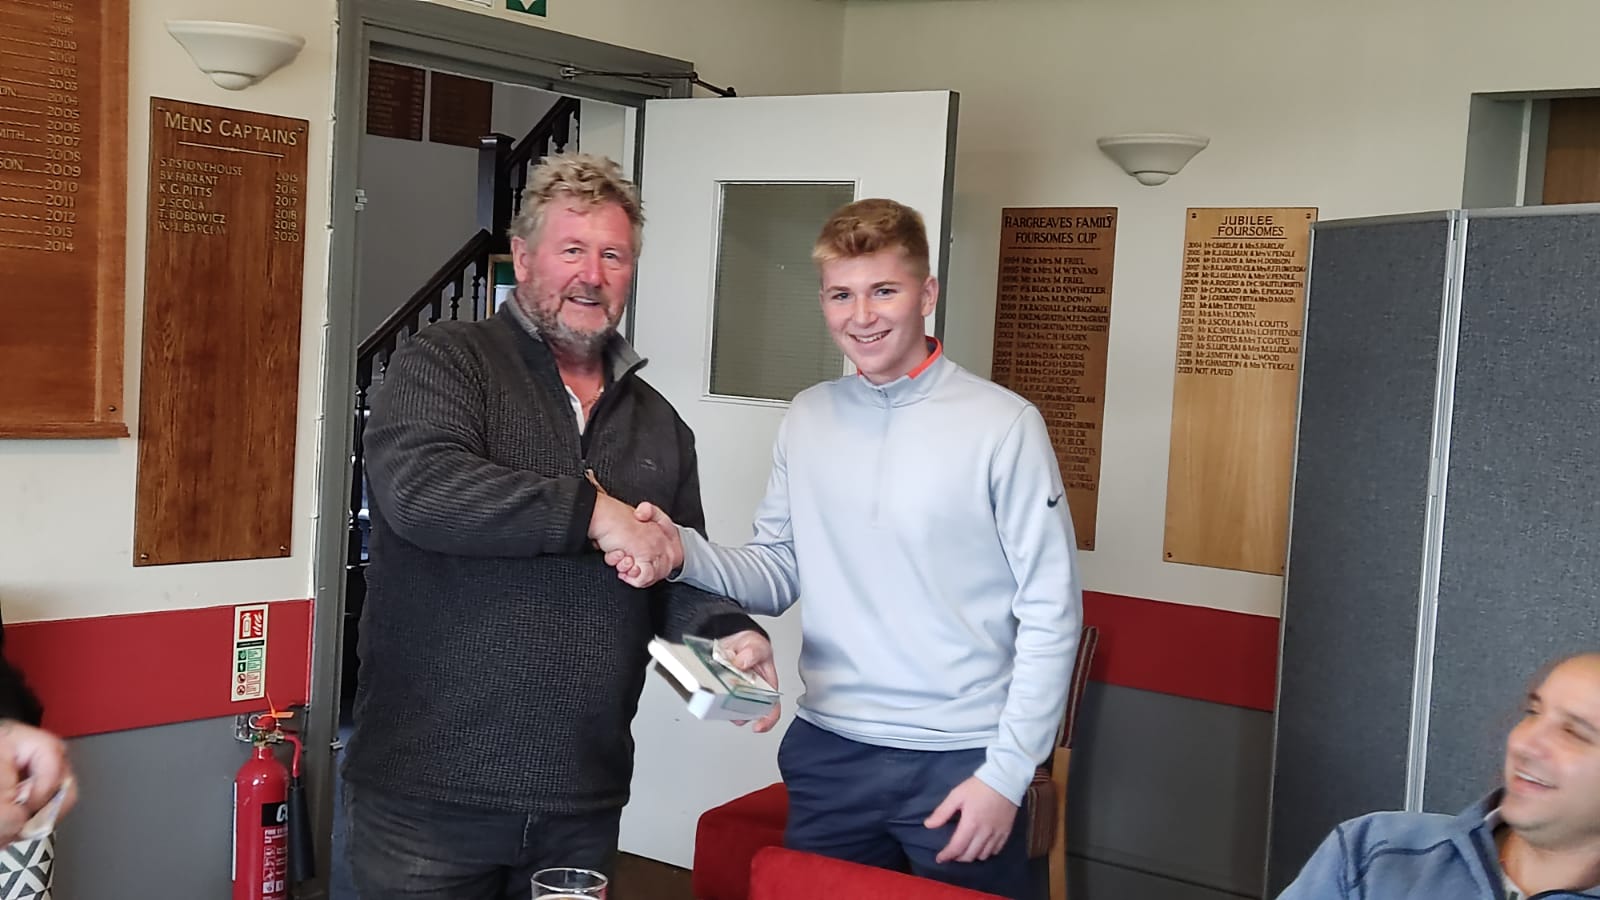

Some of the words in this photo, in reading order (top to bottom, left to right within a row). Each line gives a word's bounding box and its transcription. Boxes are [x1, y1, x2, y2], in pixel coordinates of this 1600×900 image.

[165, 111, 213, 134] MENS
[219, 119, 298, 146] CAPTAINS
[47, 133, 80, 147] 2007
[44, 162, 81, 177] 2009
[46, 179, 79, 193] 2010
[45, 194, 75, 208] 2011
[275, 195, 297, 206] 2017
[46, 208, 76, 224] 2012
[1075, 215, 1113, 229] FAMILY
[1221, 215, 1273, 225] JUBILEE
[275, 220, 297, 231] 2019
[1217, 226, 1284, 236] FOURSOMES
[1015, 232, 1074, 244] FOURSOMES
[1077, 232, 1098, 244] CUP
[45, 240, 73, 253] 2014
[1195, 367, 1209, 375] NOT
